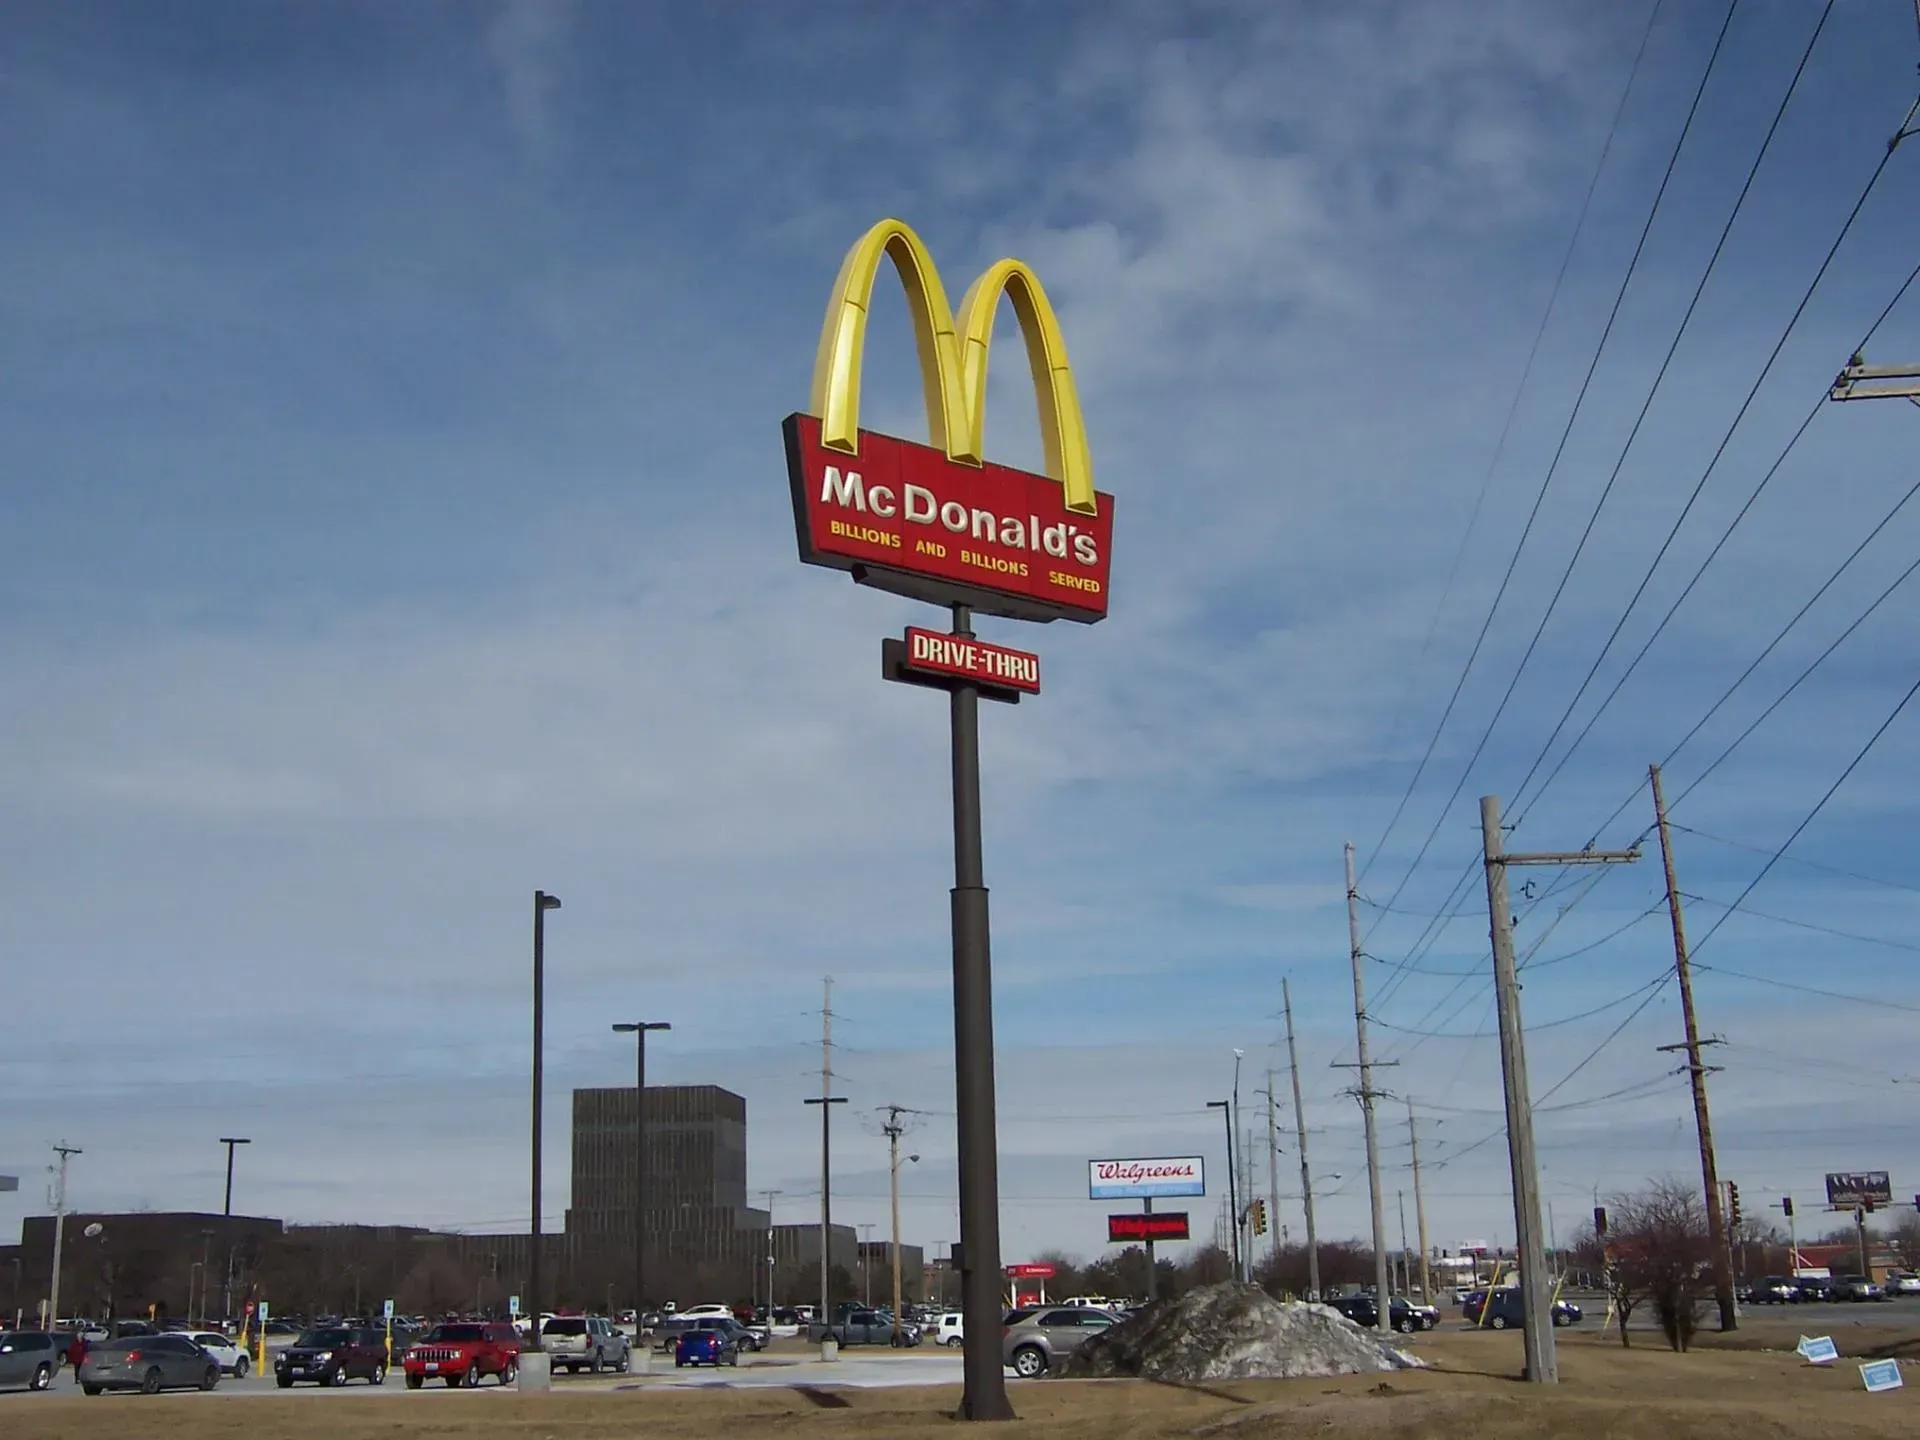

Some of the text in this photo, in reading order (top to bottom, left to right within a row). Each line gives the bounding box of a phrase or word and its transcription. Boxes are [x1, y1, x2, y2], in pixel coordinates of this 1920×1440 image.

[821, 466, 1098, 566] McDonald's
[831, 520, 1100, 593] BILLIONS AND BILLIONS SERVED
[913, 634, 1038, 682] DRIVE-THRU
[1097, 1163, 1194, 1183] Walgreens
